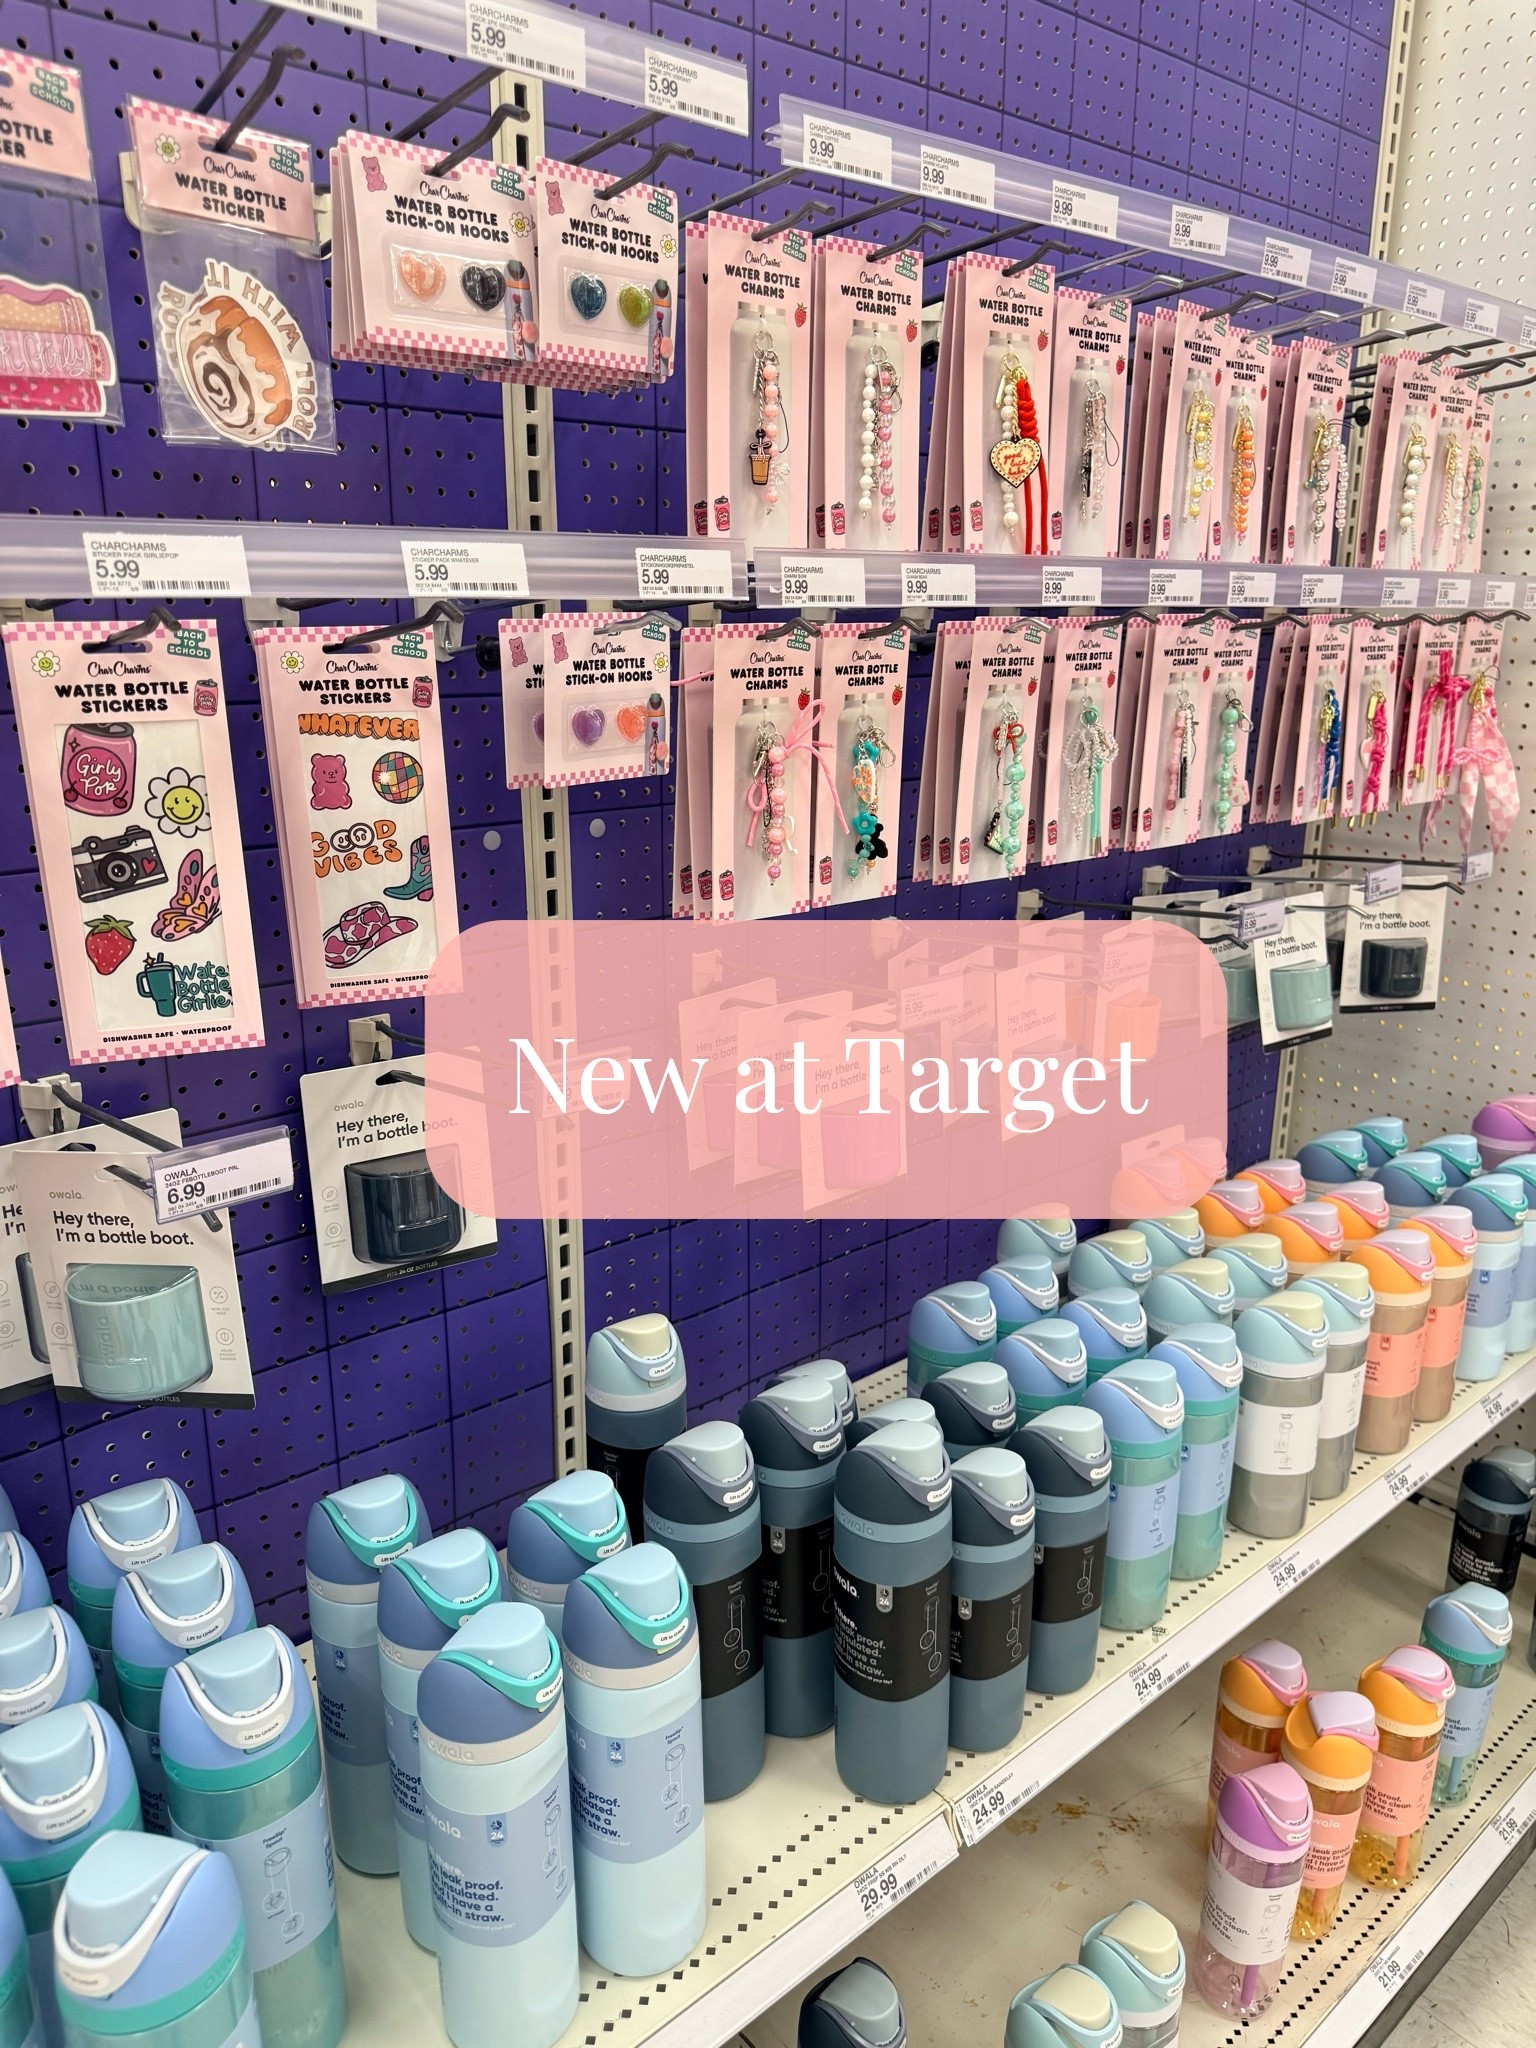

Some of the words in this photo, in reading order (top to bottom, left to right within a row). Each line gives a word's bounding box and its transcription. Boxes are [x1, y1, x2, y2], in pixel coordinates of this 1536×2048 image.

[470, 3, 529, 29] CHARCHARMS
[471, 22, 505, 49] 5.99
[649, 57, 697, 79] CHARCHARMS
[39, 71, 66, 88] BACK
[649, 74, 678, 97] 5.99
[45, 83, 58, 95] TO
[31, 87, 74, 112] SCHOOL
[809, 122, 851, 140] CHARCHARMS
[275, 146, 298, 160] BACK
[810, 138, 834, 158] 9.99
[282, 156, 292, 166] TO
[270, 159, 303, 180] SCHOOL
[498, 169, 519, 181] BACK
[923, 166, 944, 185] 9.99
[504, 177, 513, 187] TO
[175, 172, 228, 197] WATER
[234, 187, 287, 211] BOTTLE
[492, 183, 524, 199] SCHOOL
[203, 197, 265, 223] STICKER
[395, 195, 442, 216] WATER
[448, 206, 497, 226] BOTTLE
[386, 210, 455, 235] STICK-ON
[460, 223, 509, 244] HOOKS
[569, 218, 607, 238] WATER
[612, 228, 651, 248] BOTTLE
[561, 232, 616, 257] STICK-ON
[620, 244, 659, 264] HOOKS
[725, 264, 760, 280] WATER
[764, 272, 800, 288] BOTTLE
[741, 282, 785, 299] CHARMS
[841, 285, 873, 299] WATER
[878, 291, 911, 305] BOTTLE
[242, 276, 301, 353] WITH
[856, 301, 896, 316] CHARMS
[979, 298, 1008, 311] WATER
[1012, 303, 1043, 316] BOTTLE
[993, 313, 1029, 327] CHARMS
[1069, 327, 1092, 339] WATER
[1095, 332, 1121, 343] BOTTLE
[1079, 340, 1109, 352] CHARMS
[1307, 373, 1324, 383] WATER
[1325, 376, 1342, 387] BOTTLE
[1313, 385, 1333, 394] CHARMS
[293, 362, 315, 436] ROLL
[91, 541, 166, 551] CHARCHARMS
[411, 548, 469, 557] CHARCHARMS
[640, 554, 686, 562] CHARCHARMS
[96, 559, 140, 579] 5.99
[415, 564, 448, 580] 5.99
[642, 569, 669, 585] 5.99
[784, 566, 823, 574] CHARCHARMS
[785, 580, 808, 594] 9.99
[178, 631, 202, 640] BACK
[169, 646, 209, 658] SCHOOL
[393, 647, 426, 657] SCHOOL
[1066, 653, 1087, 661] WATER
[1090, 652, 1112, 660] BOTTLE
[573, 659, 606, 671] WATER
[610, 658, 645, 669] BOTTLE
[731, 668, 764, 679] WATER
[768, 666, 804, 677] BOTTLE
[835, 665, 864, 676] WATER
[867, 664, 898, 673] BOTTLE
[1075, 663, 1102, 671] CHARMS
[299, 680, 350, 691] WATER
[356, 678, 409, 690] BOTTLE
[566, 673, 614, 685] STICK-ON
[618, 671, 652, 682] HOOKS
[746, 679, 788, 690] CHARMS
[848, 676, 884, 686] CHARMS
[55, 684, 117, 698] WATER
[124, 681, 189, 695] BOTTLE
[81, 699, 168, 713] STICKERS
[320, 692, 391, 704] STICKERS
[76, 754, 122, 782] Girly
[314, 840, 402, 878] VIBES
[174, 961, 229, 980] Wate
[176, 979, 230, 996] Bottle
[330, 980, 371, 988] DISHWASHER
[103, 1033, 152, 1042] DISHWASHER
[155, 1030, 174, 1038] SAFE
[182, 1025, 232, 1035] WATERPROOF
[336, 1119, 364, 1133] Hey
[367, 1112, 409, 1127] there,
[338, 1136, 360, 1149] I'm
[364, 1133, 373, 1143] a
[377, 1123, 418, 1140] bottle
[164, 1167, 197, 1182] OWALA
[167, 1181, 205, 1204] 6.99
[53, 1210, 83, 1229] Hey
[88, 1212, 134, 1229] there,
[56, 1229, 80, 1243] I'm
[84, 1232, 95, 1243] a
[99, 1229, 147, 1245] bottle
[150, 1231, 194, 1245] boot.
[838, 1608, 857, 1630] there.
[857, 1634, 886, 1649] proof.
[855, 1661, 884, 1677] straw.
[1135, 1668, 1161, 1696] 24.99
[261, 1722, 279, 1736] Unlock
[973, 1790, 1004, 1825] 24.99
[491, 1831, 504, 1840] 24
[440, 1865, 461, 1886] leak
[465, 1881, 503, 1891] proof.
[854, 1867, 878, 1889] OWALA
[441, 1876, 499, 1901] insulated.
[861, 1873, 897, 1912] 29.99
[465, 1912, 504, 1922] straw.
[1379, 1960, 1400, 1988] 21.99
